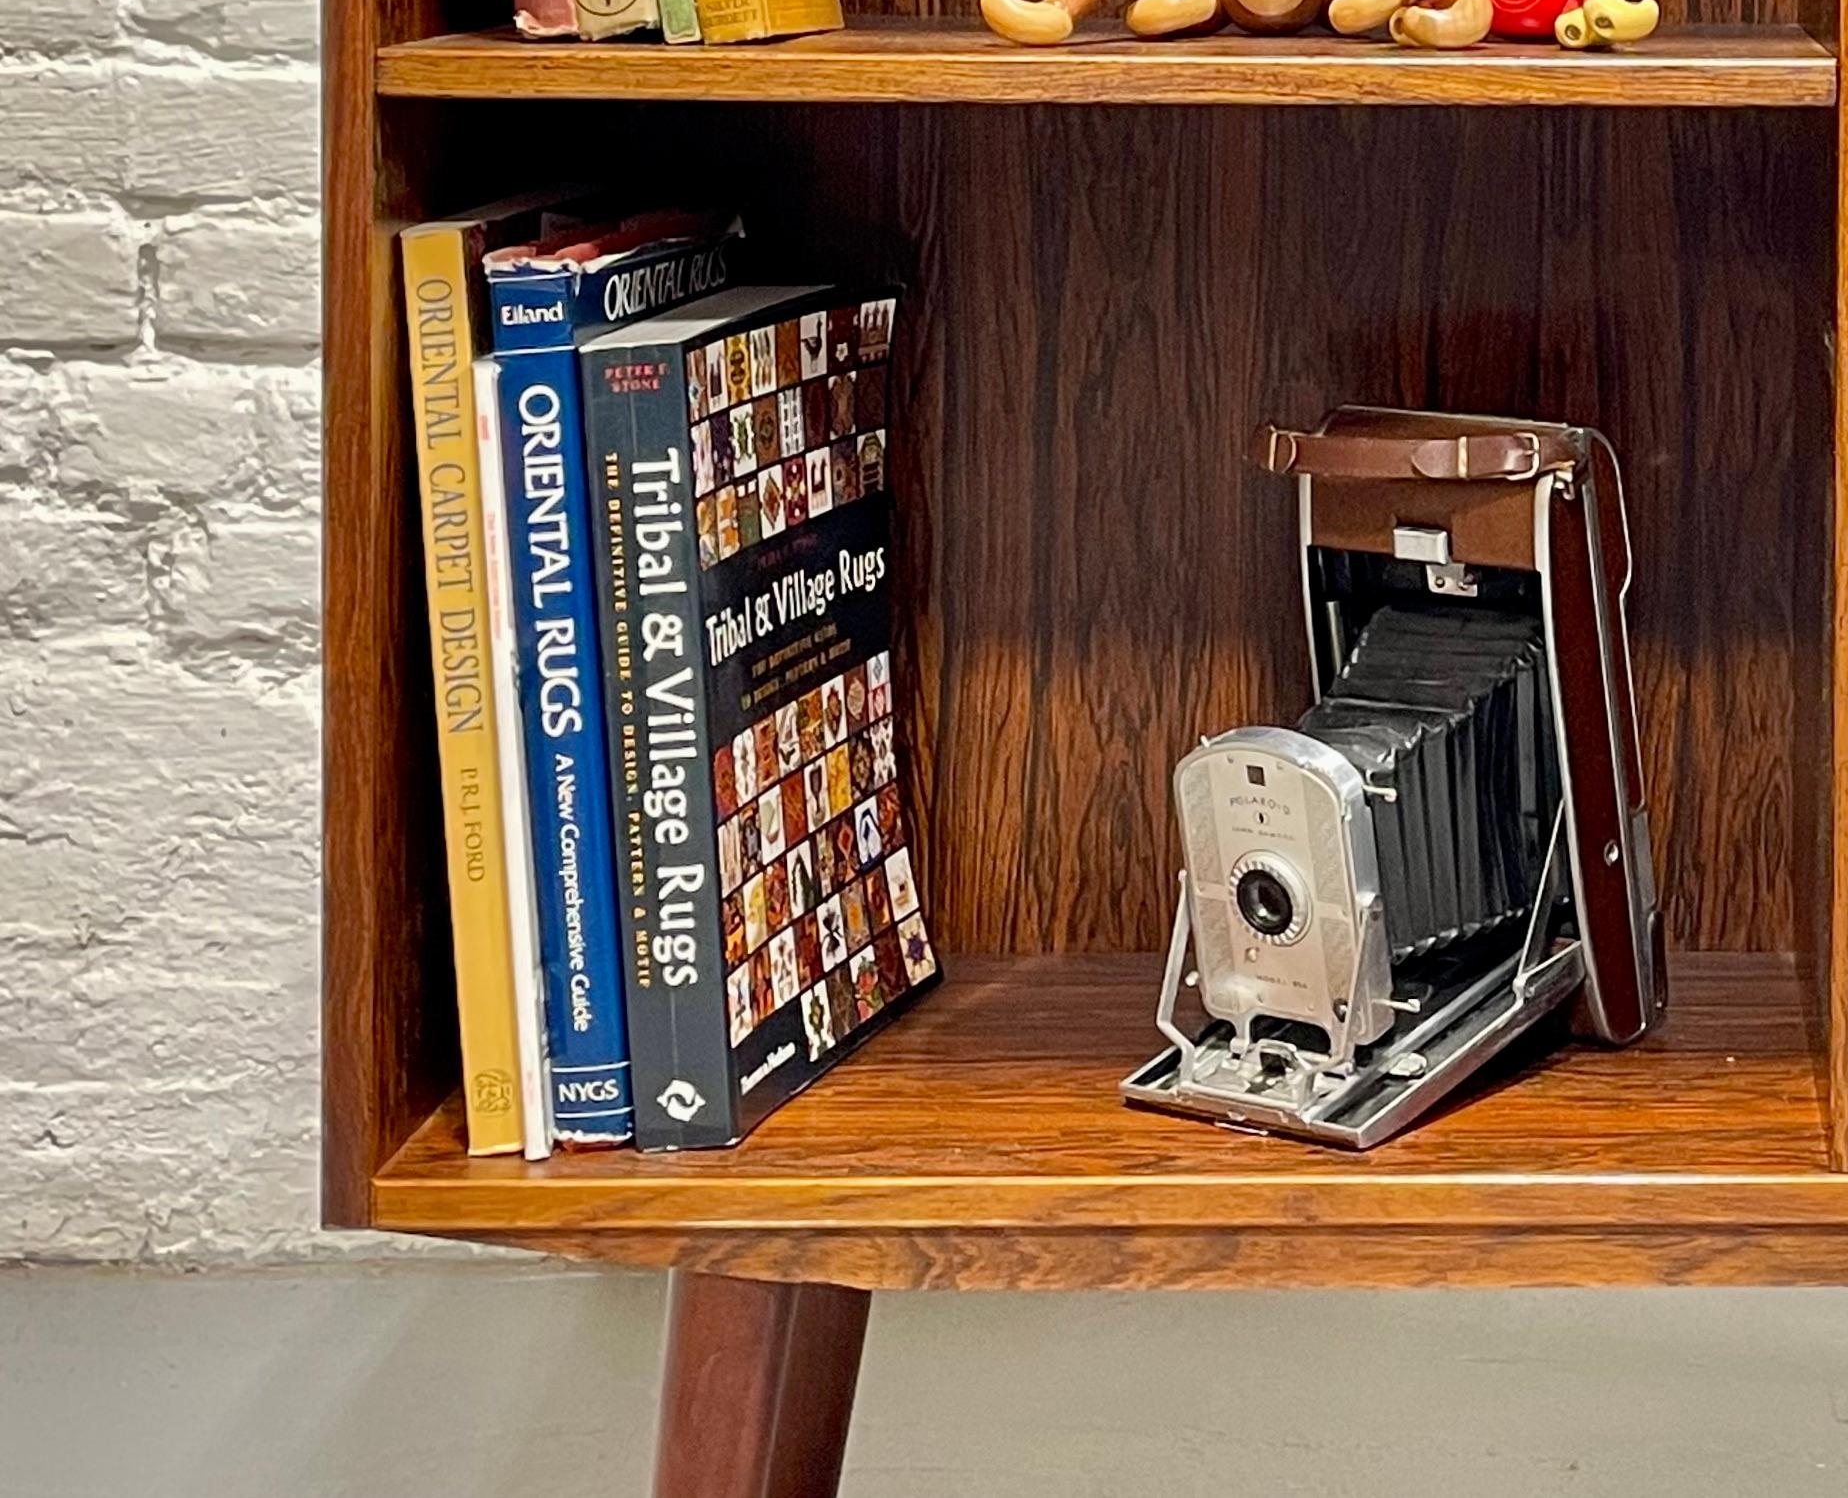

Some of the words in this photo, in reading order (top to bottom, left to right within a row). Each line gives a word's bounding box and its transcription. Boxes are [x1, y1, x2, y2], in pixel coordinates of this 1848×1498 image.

[604, 259, 685, 322] ORIENTAL
[688, 246, 727, 295] RUGS
[415, 278, 462, 451] ORIENTAL
[604, 364, 653, 380] PETER
[612, 380, 660, 393] STONE
[518, 383, 573, 610] ORIENTAL
[605, 452, 620, 490] THE
[428, 462, 475, 594] CARPET
[607, 498, 628, 613] DEFINITIVE
[631, 447, 687, 595] Tribal
[641, 612, 684, 662] &
[705, 595, 753, 667] Tribal
[755, 592, 774, 638] &
[772, 568, 836, 627] Village
[838, 547, 886, 595] Rugs
[440, 607, 485, 735] DESIGN
[534, 617, 583, 738] RUGS
[616, 621, 632, 681] GUIDE
[620, 690, 634, 715] TO
[555, 753, 575, 773] A
[643, 667, 697, 845] Village
[464, 821, 486, 883] FORD
[627, 811, 646, 897] PATTERN
[559, 823, 585, 972] Comprehensive
[652, 864, 705, 988] Rugs
[634, 929, 651, 989] MOTIF
[570, 973, 592, 1033] Guide
[558, 1079, 620, 1103] NYGS
